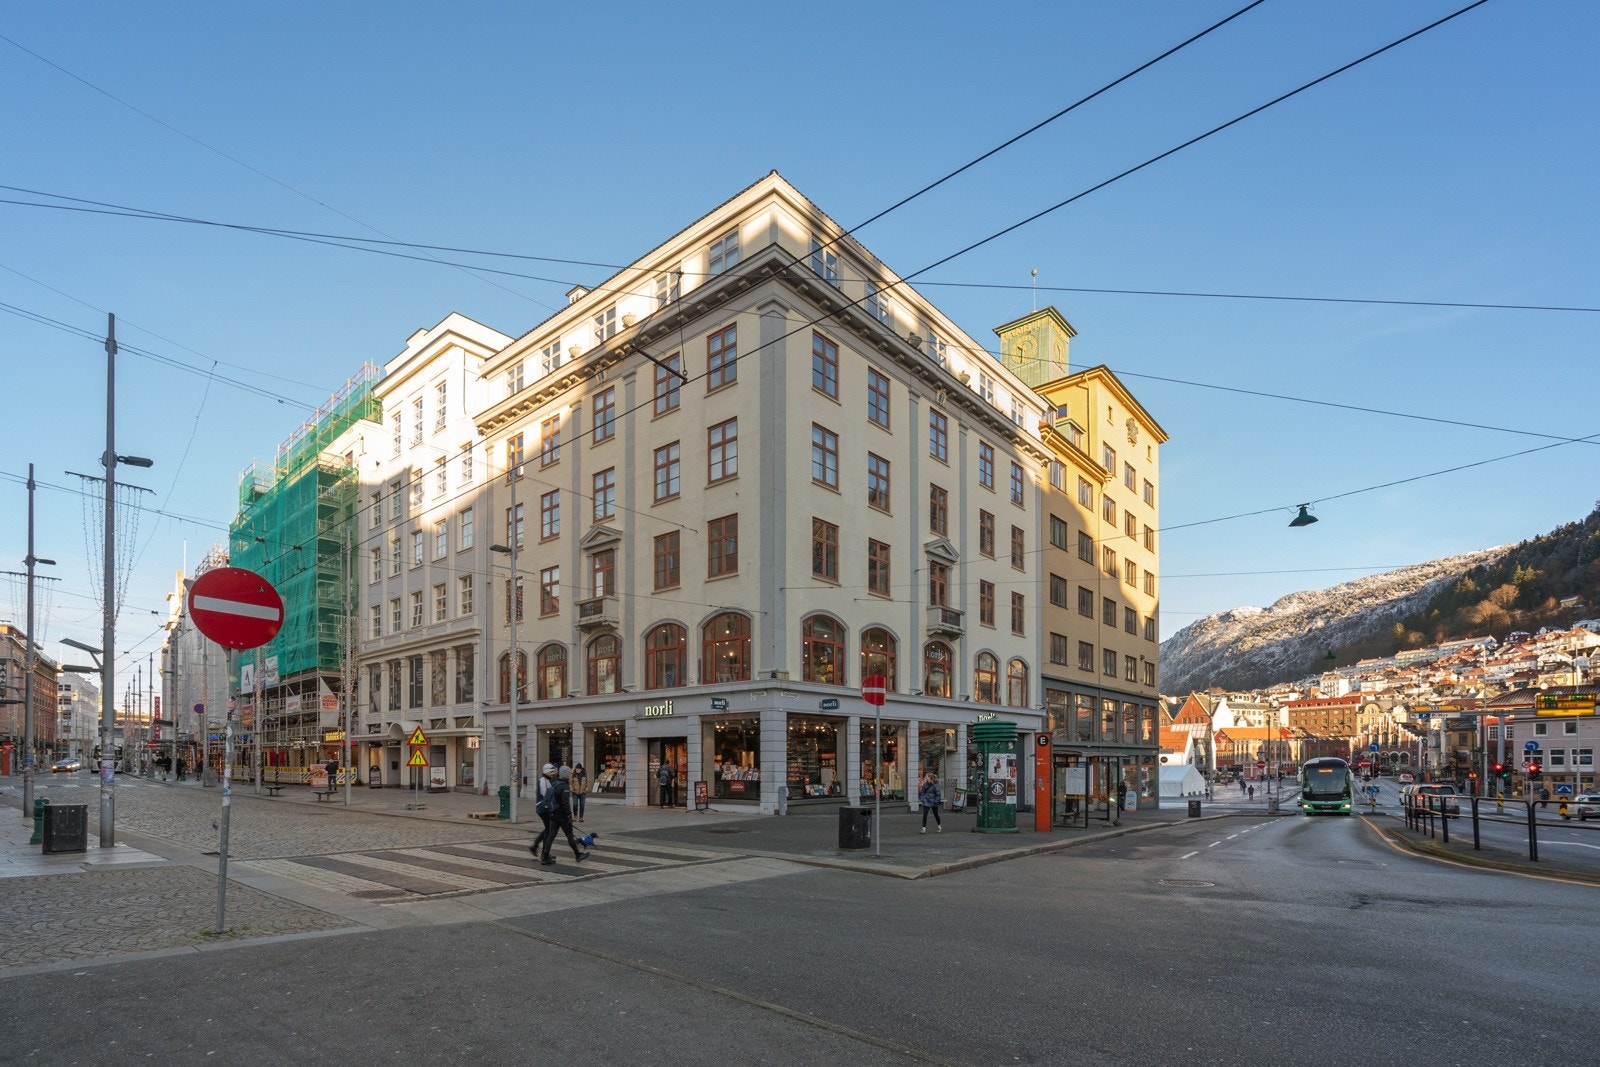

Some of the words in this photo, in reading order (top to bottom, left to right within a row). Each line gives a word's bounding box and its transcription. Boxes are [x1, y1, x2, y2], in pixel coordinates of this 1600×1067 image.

[645, 700, 673, 716] norli
[823, 700, 837, 708] norli
[1040, 736, 1046, 745] E
